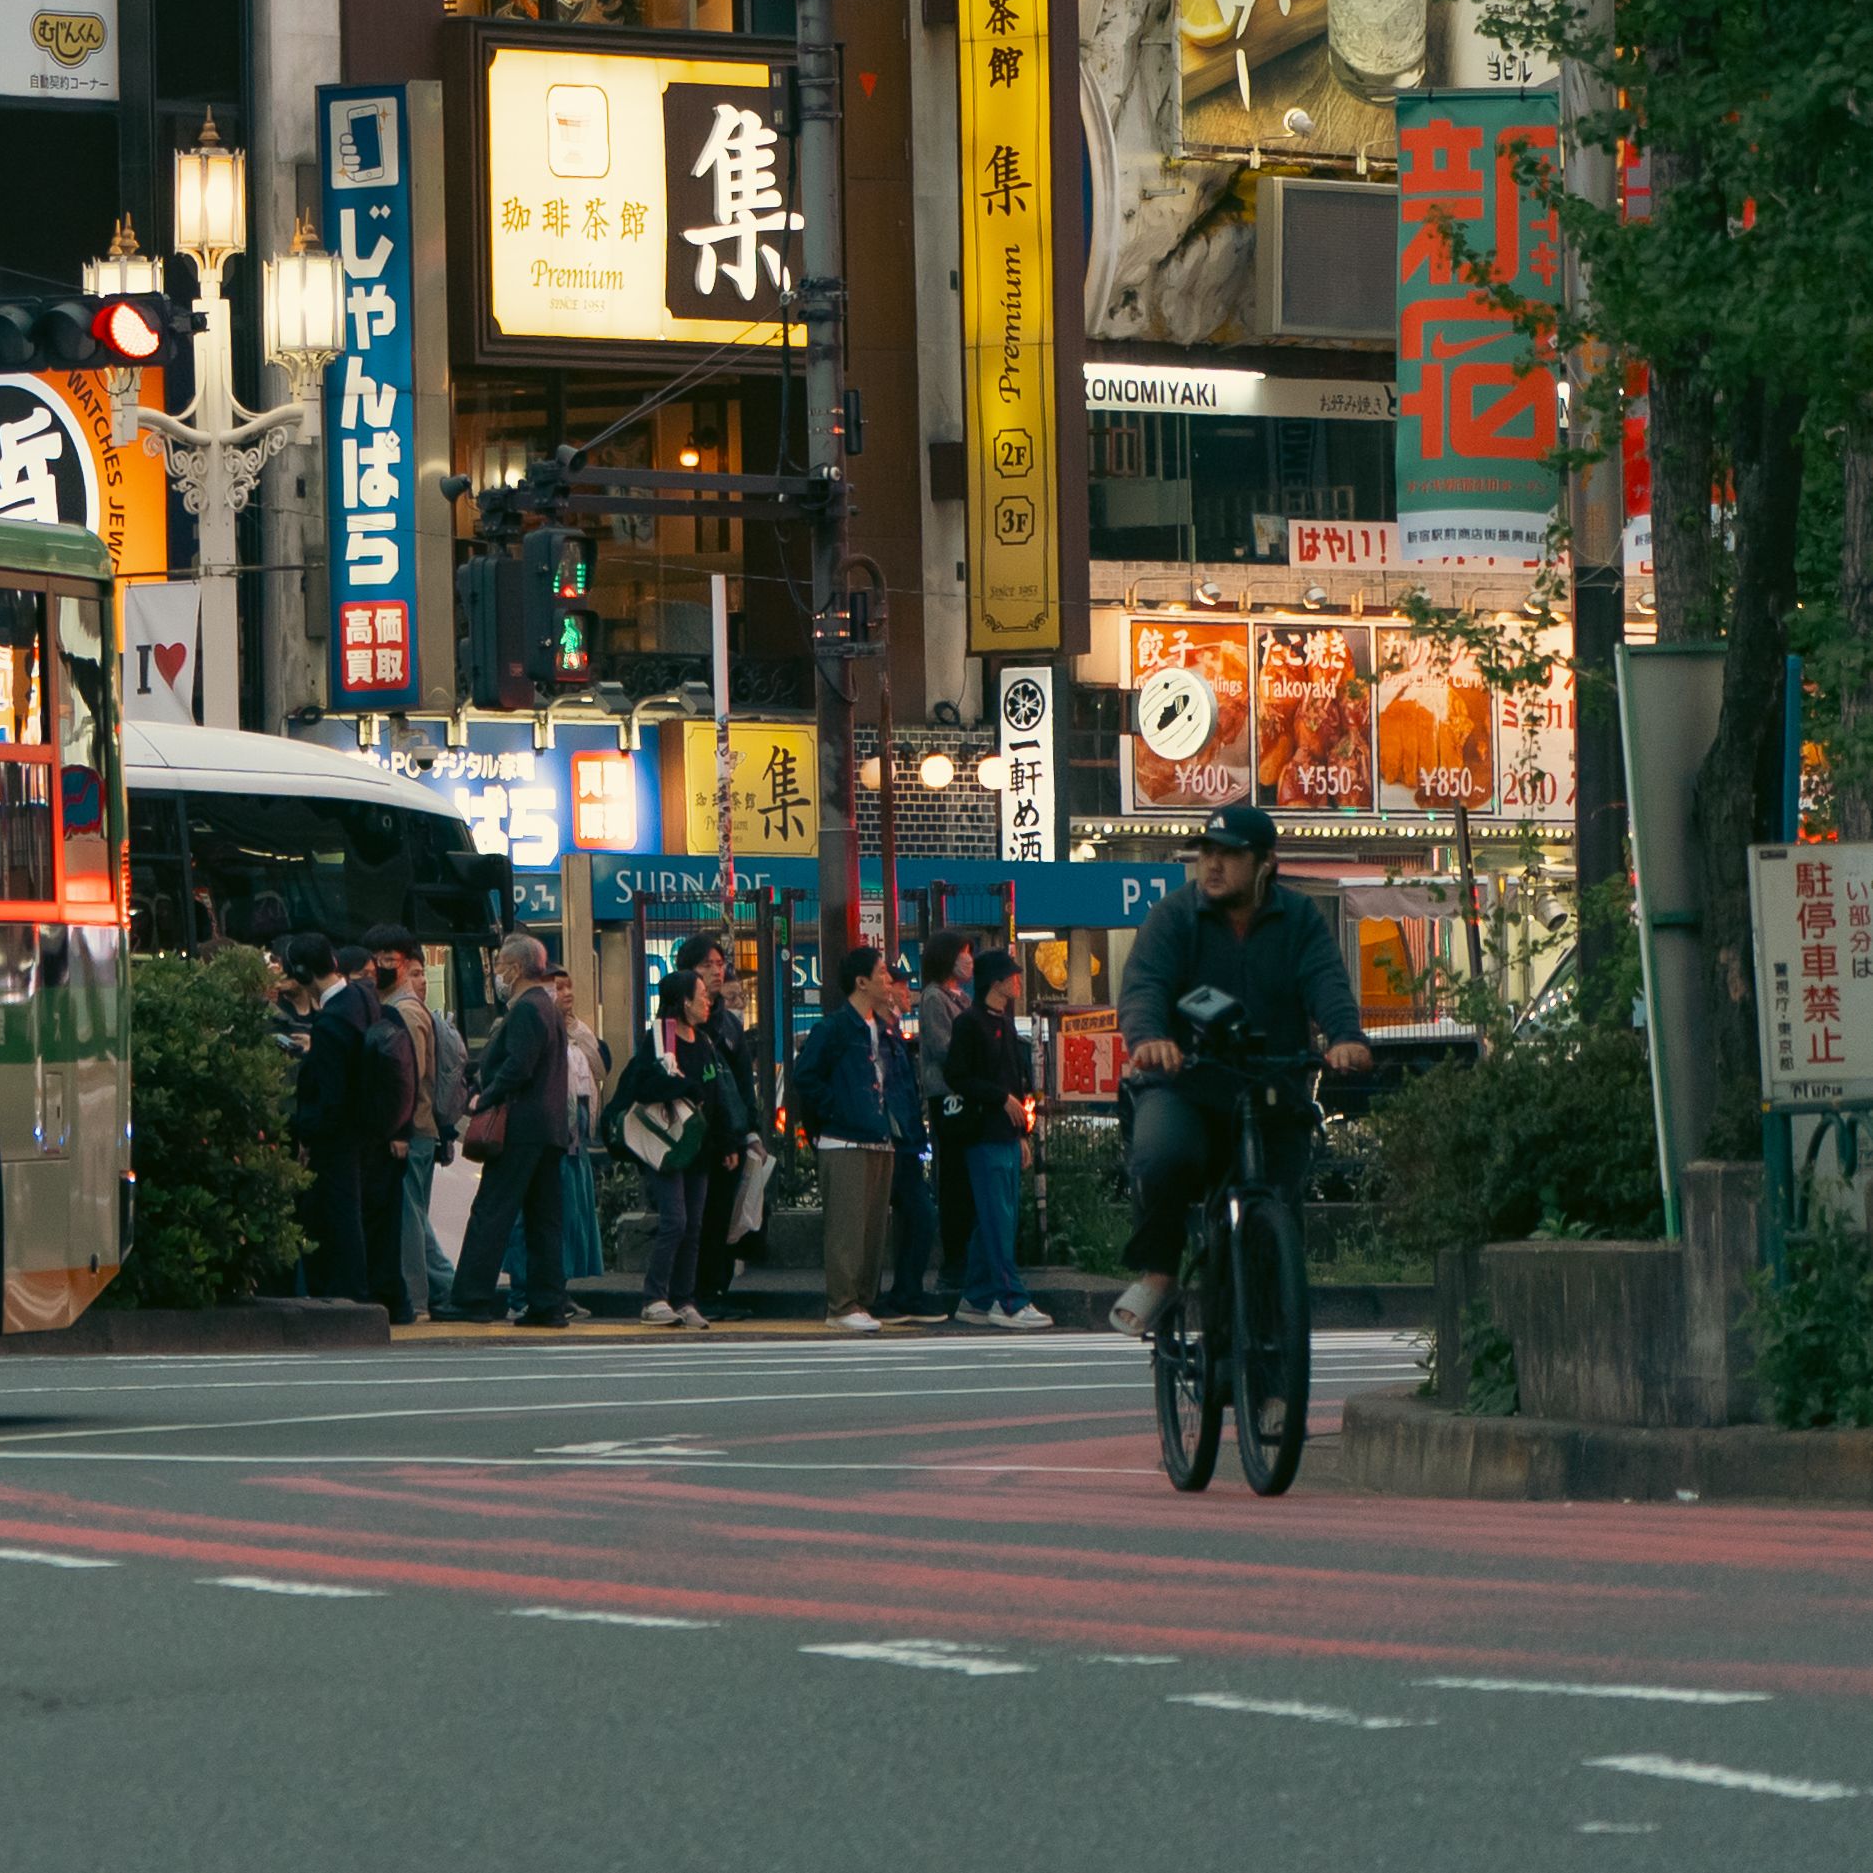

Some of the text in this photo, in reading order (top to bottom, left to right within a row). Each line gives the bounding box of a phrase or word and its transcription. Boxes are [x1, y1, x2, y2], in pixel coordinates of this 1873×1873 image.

[38, 20, 101, 58] むじんくん
[679, 103, 806, 302] 集
[979, 144, 1034, 217] 集
[501, 196, 649, 244] 珈琲茶館
[529, 259, 626, 292] Premium
[998, 243, 1023, 405] Premium
[340, 206, 402, 586] じゃんぱら
[1001, 441, 1027, 468] 2F
[1002, 509, 1028, 535] 3F
[1138, 628, 1194, 670] 餃子
[1260, 629, 1346, 670] たこ焼き
[1260, 675, 1340, 701] Takoyaki
[757, 744, 812, 842] 集
[1795, 861, 1845, 1064] 駐停車禁止
